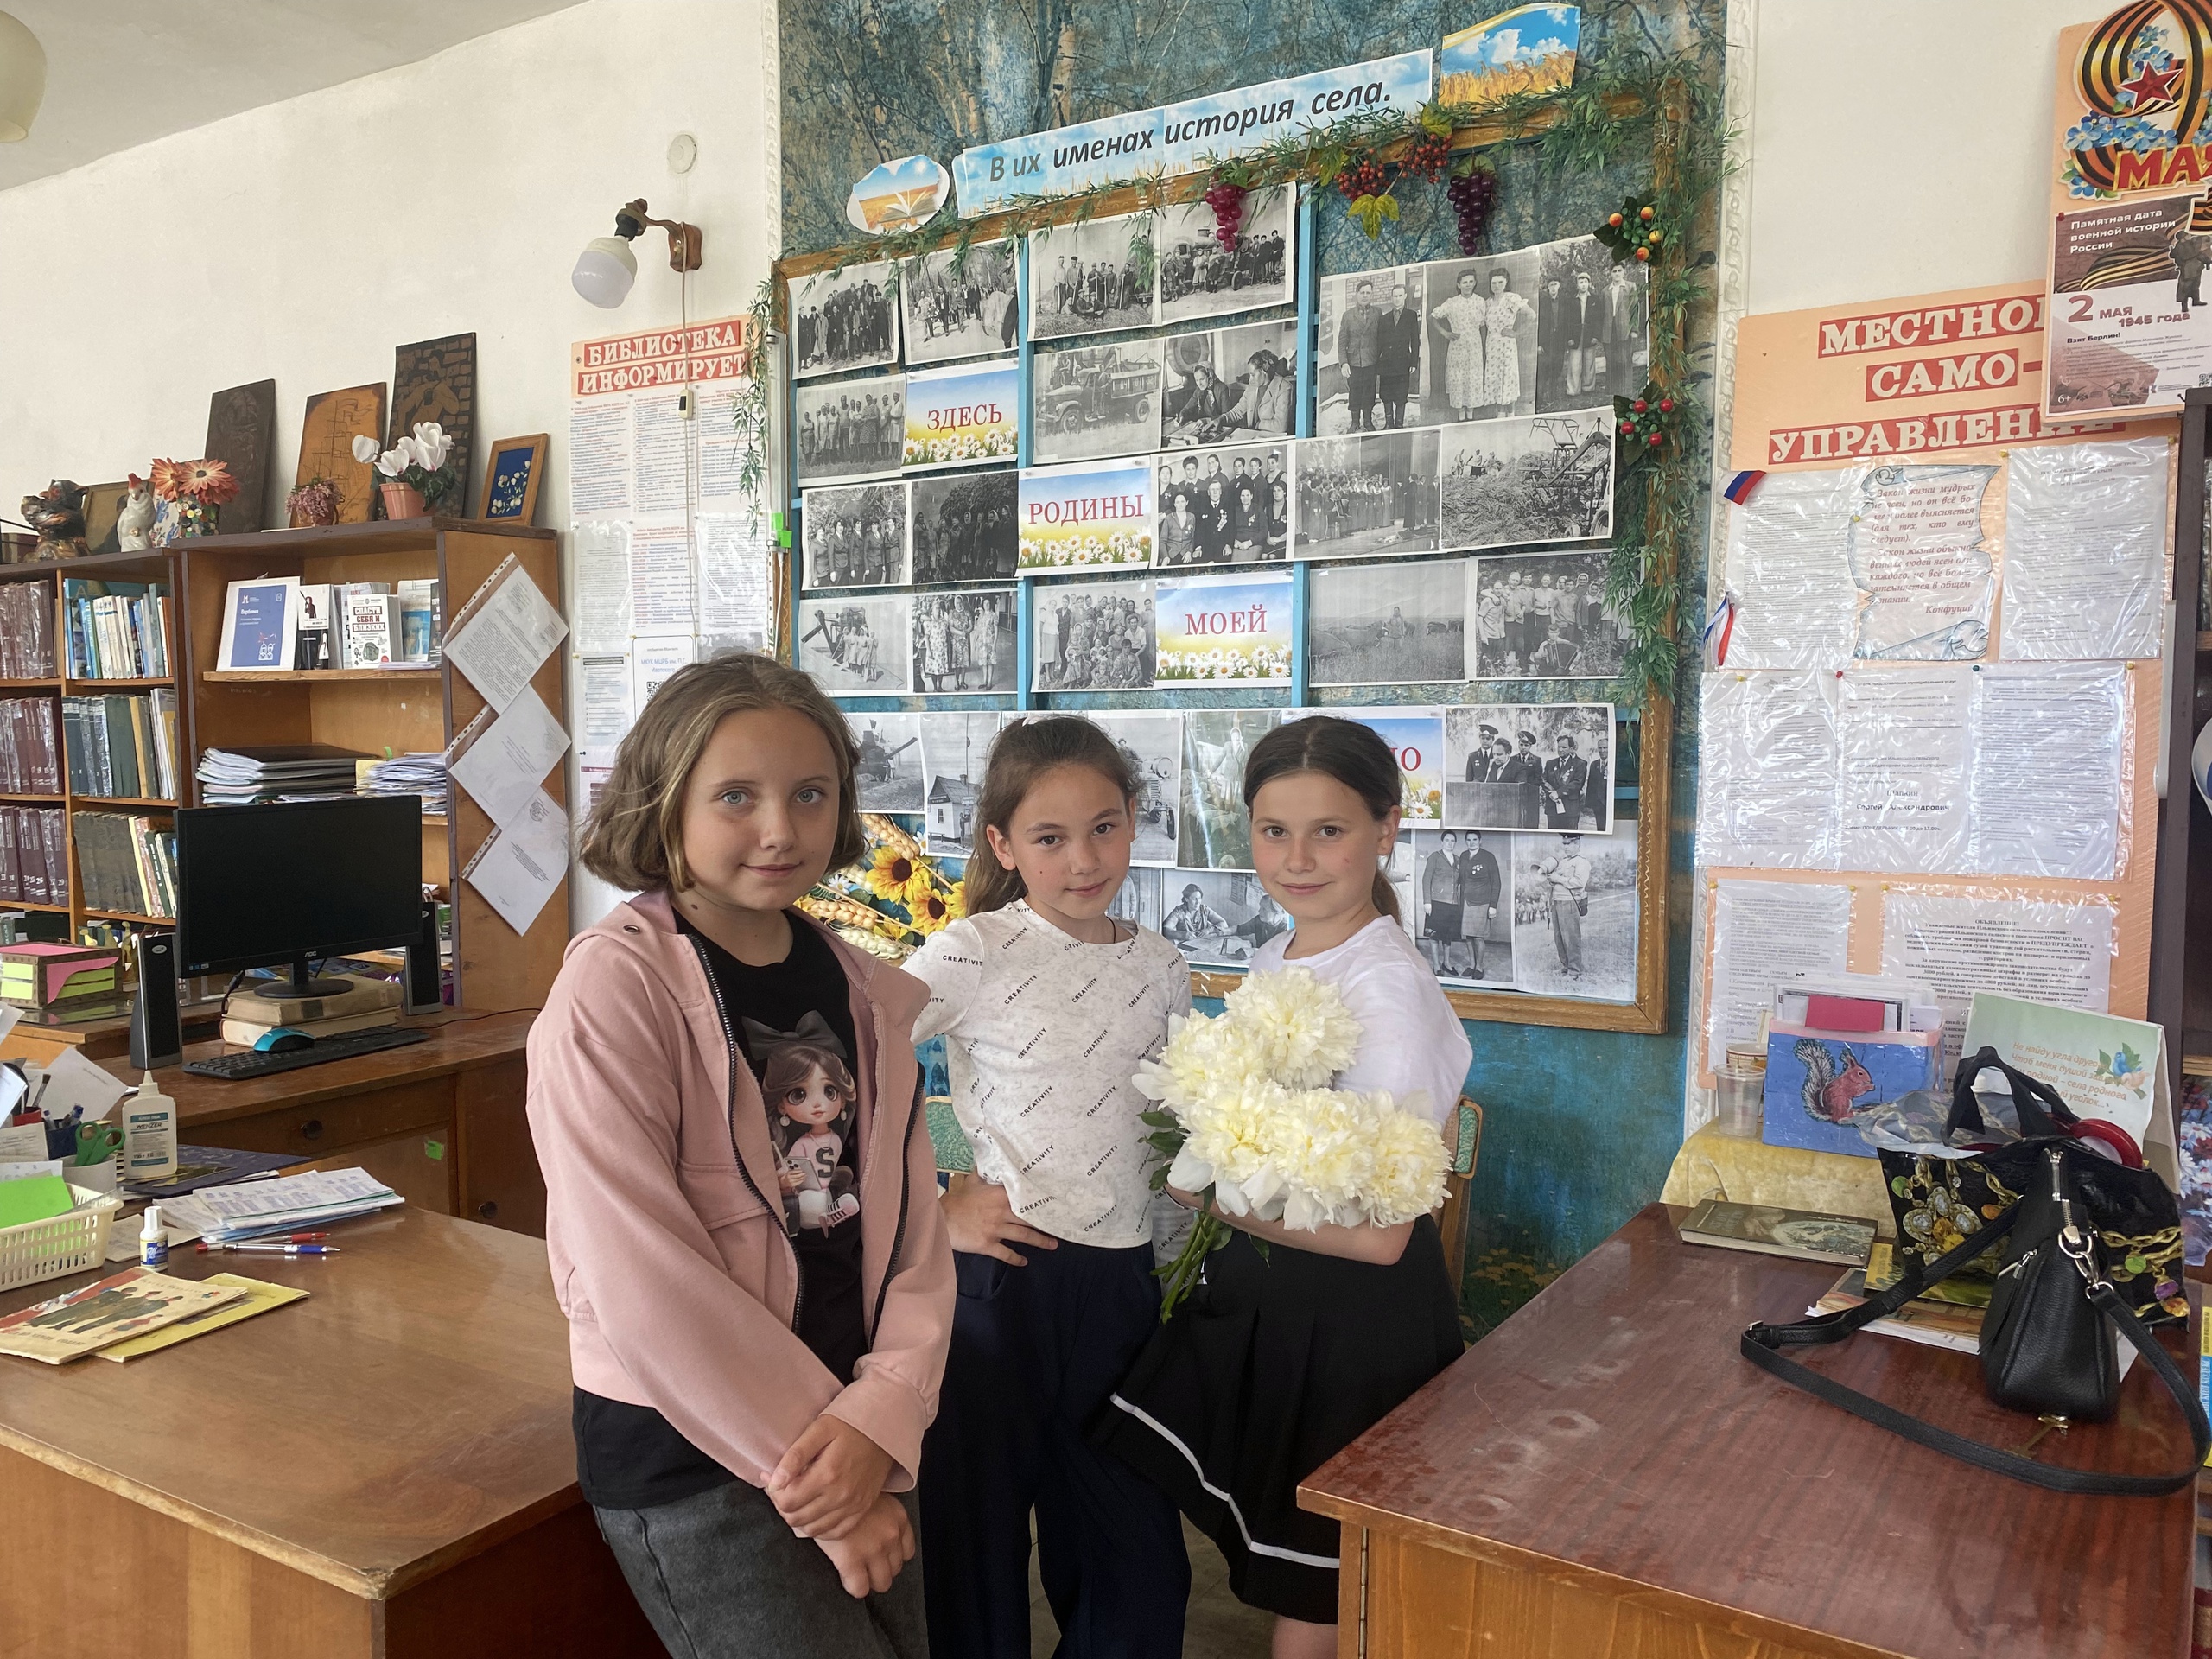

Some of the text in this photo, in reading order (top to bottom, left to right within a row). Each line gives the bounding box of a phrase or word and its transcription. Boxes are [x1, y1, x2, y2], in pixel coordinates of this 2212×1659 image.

[990, 80, 1392, 182] В их именах история села.
[2070, 209, 2163, 231] Памятная дата
[2070, 220, 2176, 242] военной истории
[2069, 242, 2113, 254] России
[2068, 294, 2133, 323] 2 МАЯ
[2119, 312, 2190, 327] 1945 года
[1821, 299, 2044, 355] МЕСТНО
[2088, 332, 2121, 342] Берлин!
[588, 324, 736, 366] БИБЛИОТЕКА
[581, 352, 745, 394] ИНФОРМИРУЕТ
[2057, 394, 2072, 404] 6+
[927, 404, 1002, 433] ЗДЕСЬ
[1770, 405, 2113, 462] УПРАВЛЕН
[1908, 486, 1936, 496] жизни
[1939, 484, 1976, 495] мудрых
[1942, 495, 1956, 505] всё
[1960, 494, 1975, 503] бо-
[1029, 493, 1144, 527] РОДИНЫ
[1920, 507, 1975, 518] выясняется
[1956, 519, 1974, 529] ему
[1932, 582, 1938, 590] в
[1940, 580, 1971, 589] общем
[1185, 603, 1268, 636] МОЕЙ
[1925, 604, 1974, 615] Конфуций
[1857, 803, 1884, 813] Сергей
[1002, 927, 1028, 950] CREATIVITY
[1004, 975, 1038, 1005] CREATIVITY
[1071, 978, 1097, 1003] CREATIVITY
[1128, 983, 1150, 1008] CREATIVITY
[1017, 1027, 1047, 1059] CREATIVITY
[1084, 1029, 1109, 1058] CREATIVITY
[2012, 1041, 2072, 1062] Не найду угла
[2035, 1060, 2057, 1071] меня
[2059, 1065, 2088, 1078] душой
[1020, 1085, 1054, 1118] CREATIVITY
[1086, 1085, 1117, 1117] CREATIVITY
[2066, 1080, 2088, 1090] села
[2088, 1084, 2127, 1101] родного
[816, 1147, 835, 1179] S
[1087, 1144, 1119, 1178] CREATIVITY
[1084, 1204, 1118, 1232] CREATIVITY
[1158, 1221, 1188, 1251] CREATIVITY
